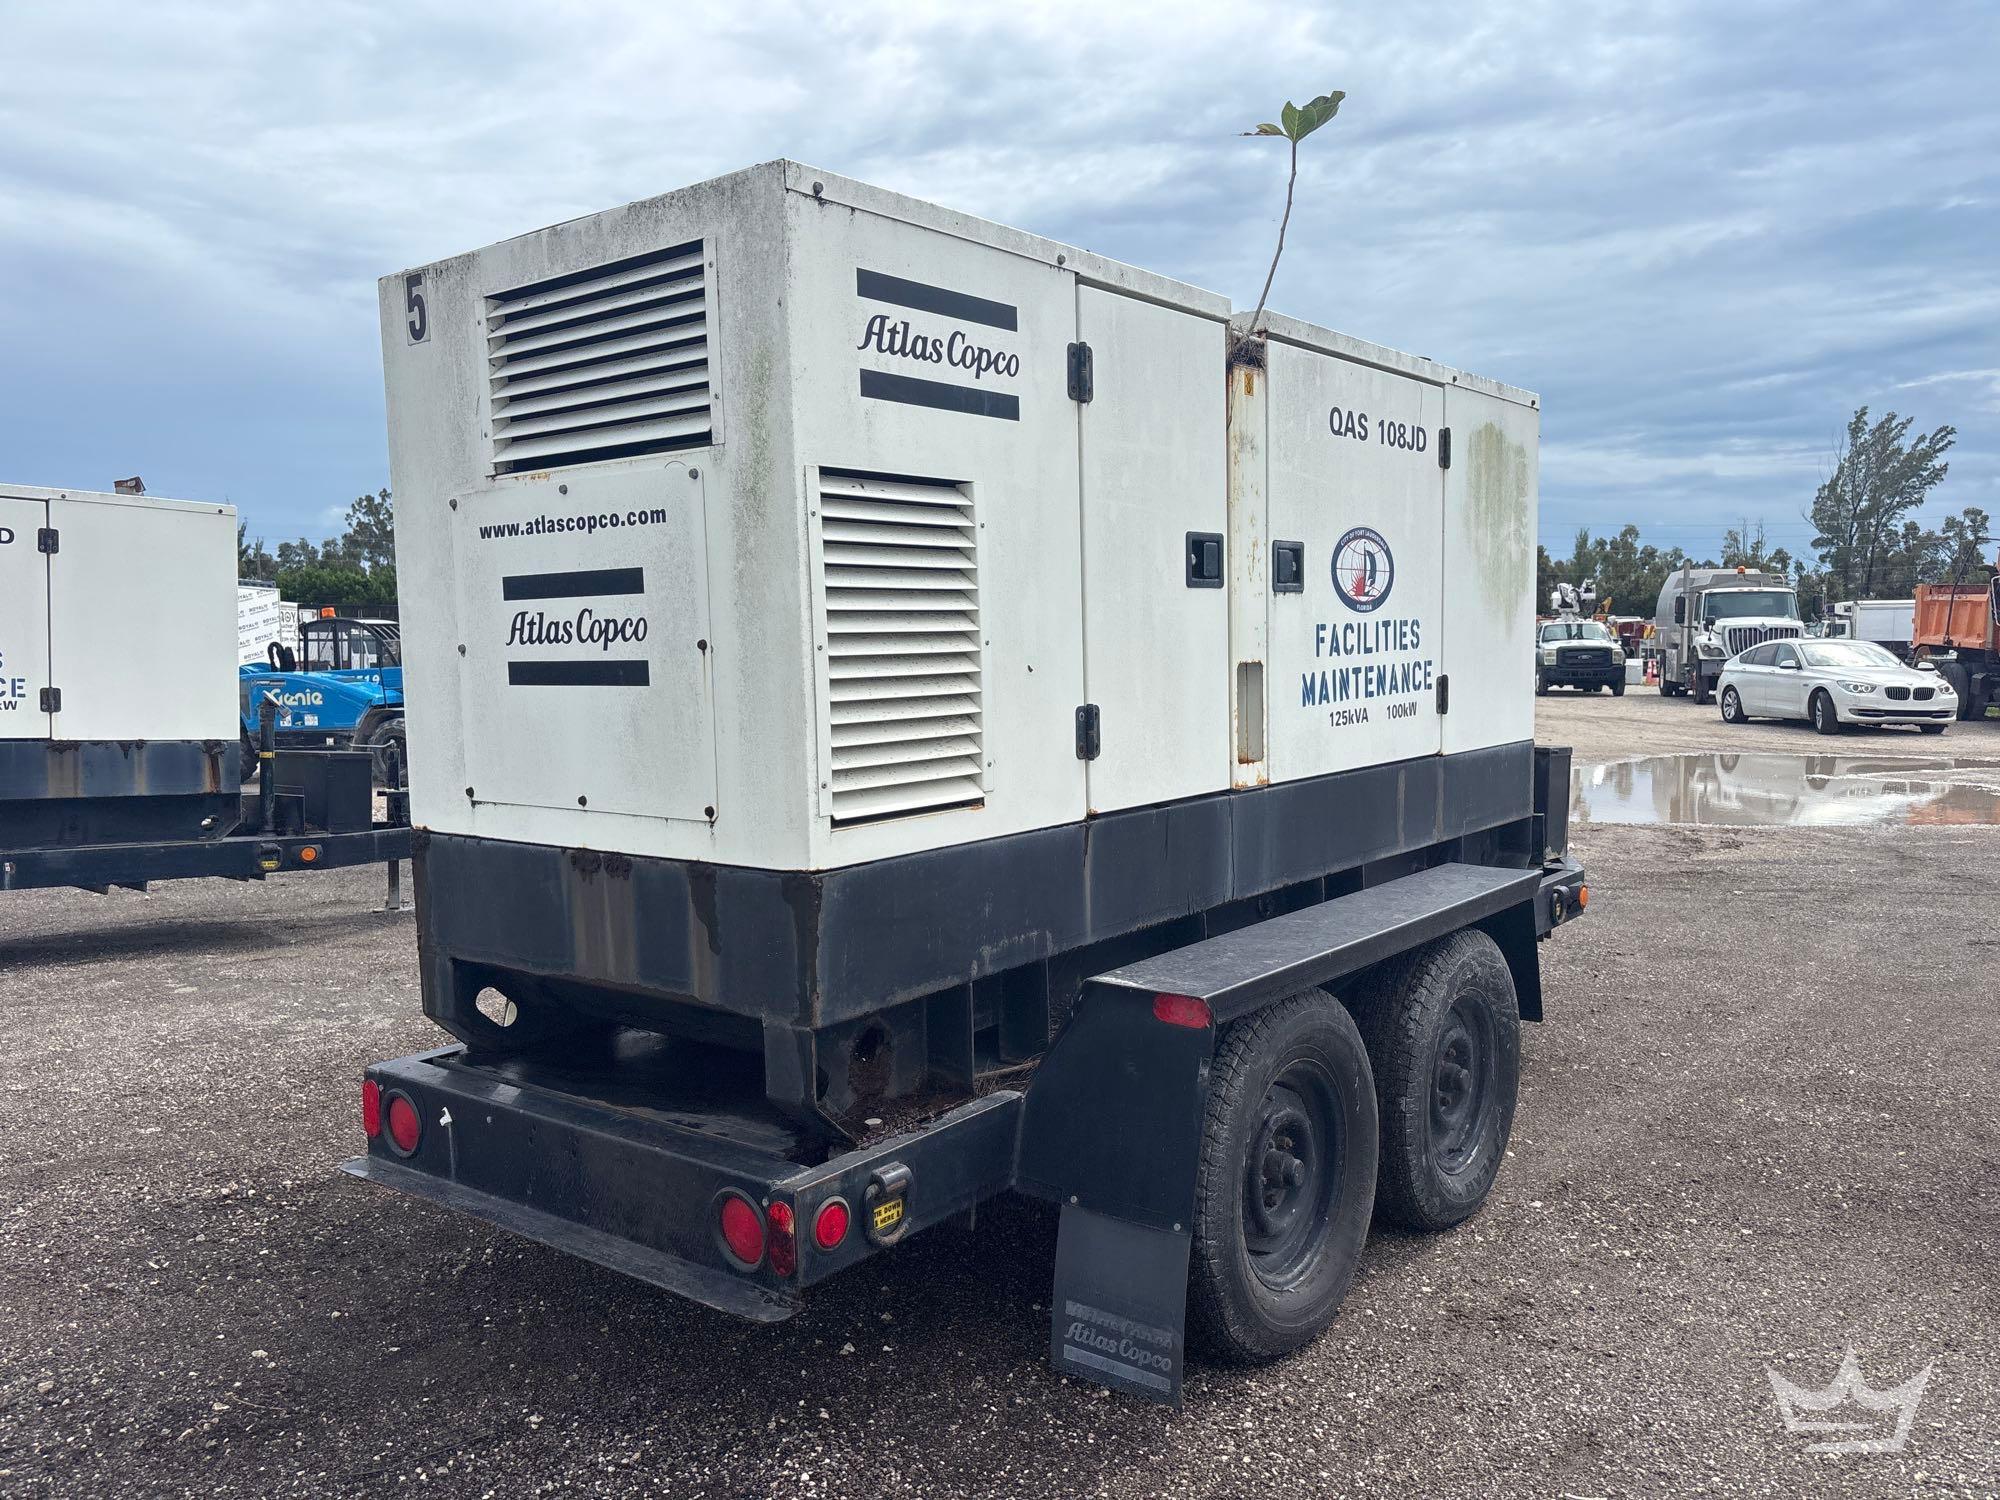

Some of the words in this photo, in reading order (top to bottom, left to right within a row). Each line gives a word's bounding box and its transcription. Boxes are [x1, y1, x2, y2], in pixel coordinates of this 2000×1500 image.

[406, 273, 427, 342] 5
[856, 314, 944, 364] Atlas
[946, 330, 1020, 380] Copco
[1329, 406, 1369, 442] QAS
[1378, 419, 1427, 453] 108JD
[479, 508, 667, 540] www.atlascopco.com
[505, 610, 574, 647] Atlas
[576, 607, 648, 652] Copco
[1315, 619, 1420, 658] FACILITIES
[1301, 660, 1433, 708] MAINTENANCE
[1329, 707, 1369, 727] 125kVA
[1386, 701, 1417, 720] 100kW
[884, 1201, 901, 1213] DOWN
[1063, 1321, 1118, 1354] Atlas
[1118, 1338, 1172, 1372] Copco
